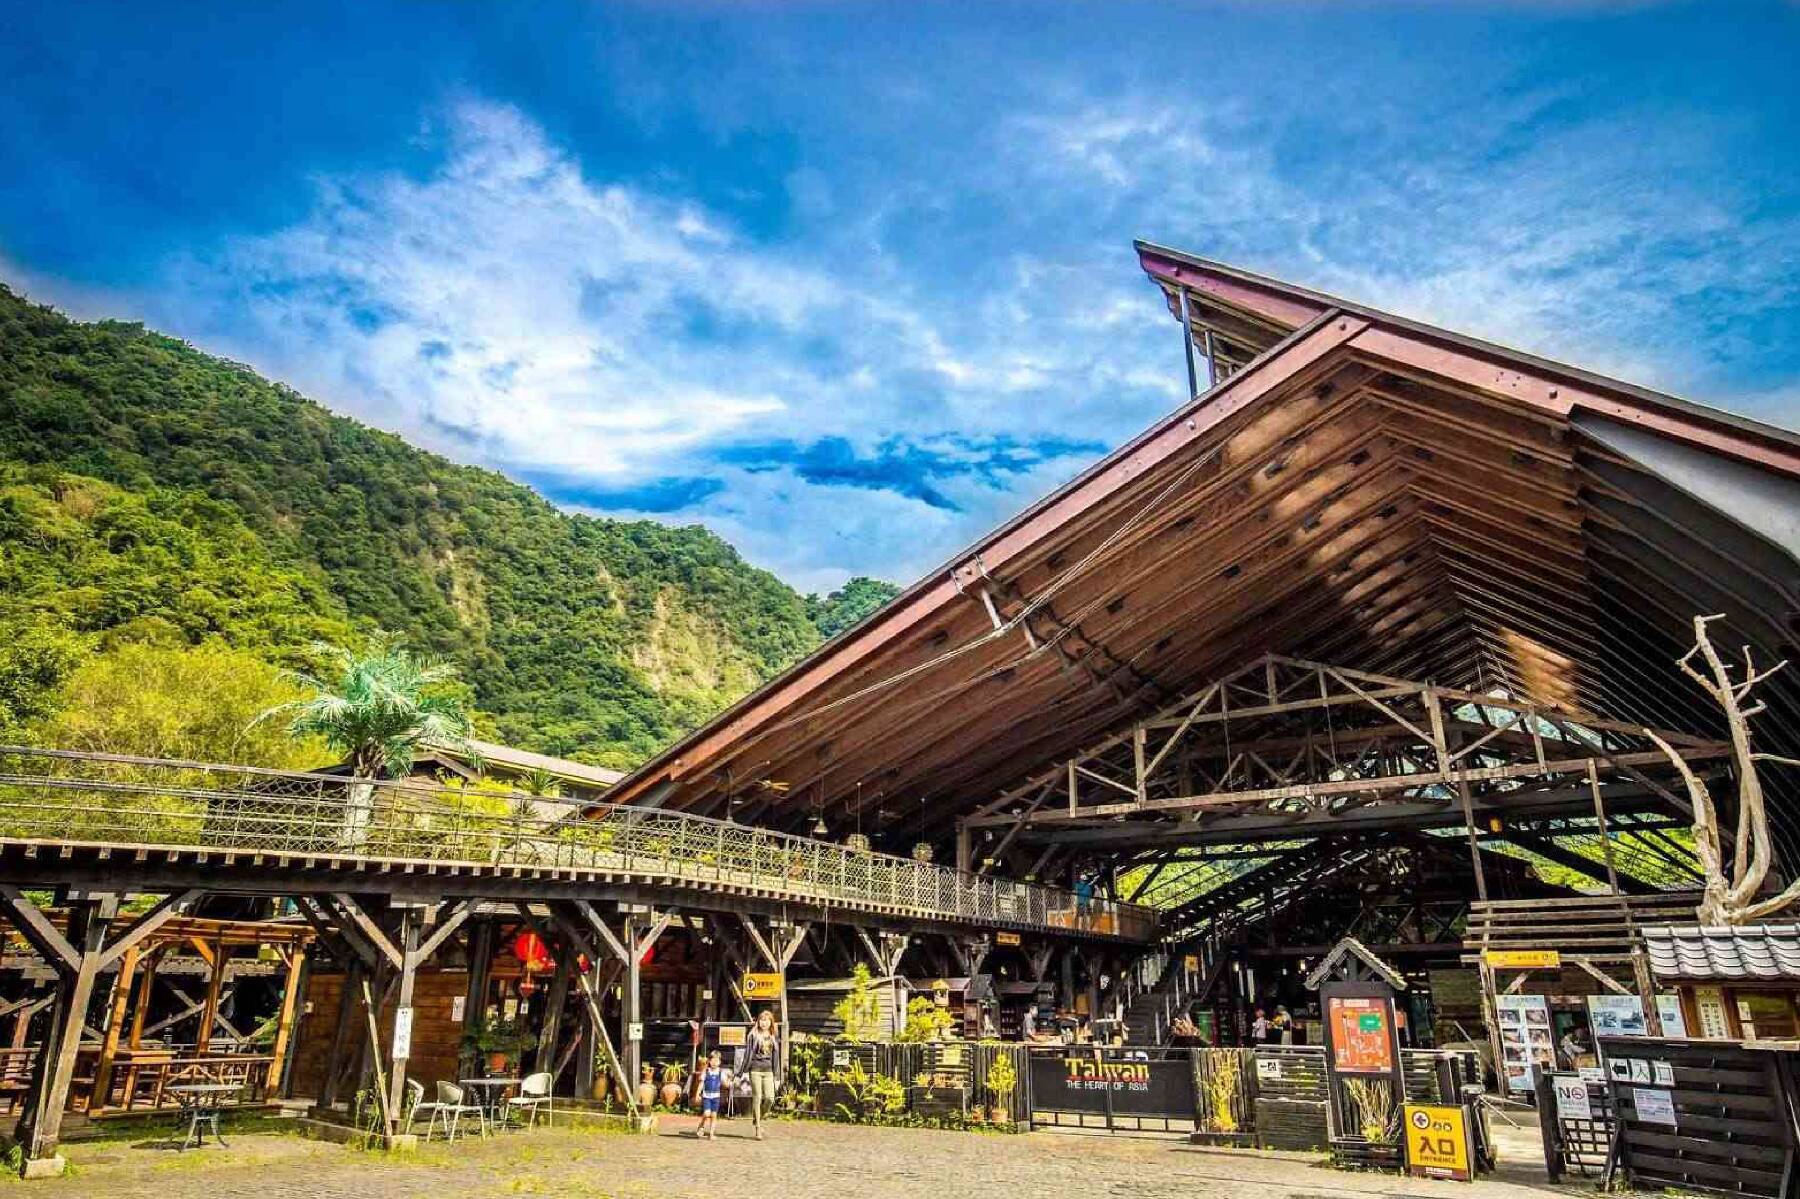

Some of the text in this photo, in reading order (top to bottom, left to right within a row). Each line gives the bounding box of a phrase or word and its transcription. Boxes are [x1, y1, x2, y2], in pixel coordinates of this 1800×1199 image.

[1065, 1058, 1149, 1081] Taiwan
[1636, 1064, 1671, 1080] 入口
[1067, 1080, 1148, 1091] THE HEART OF ASIA
[1419, 1136, 1456, 1156] 入口
